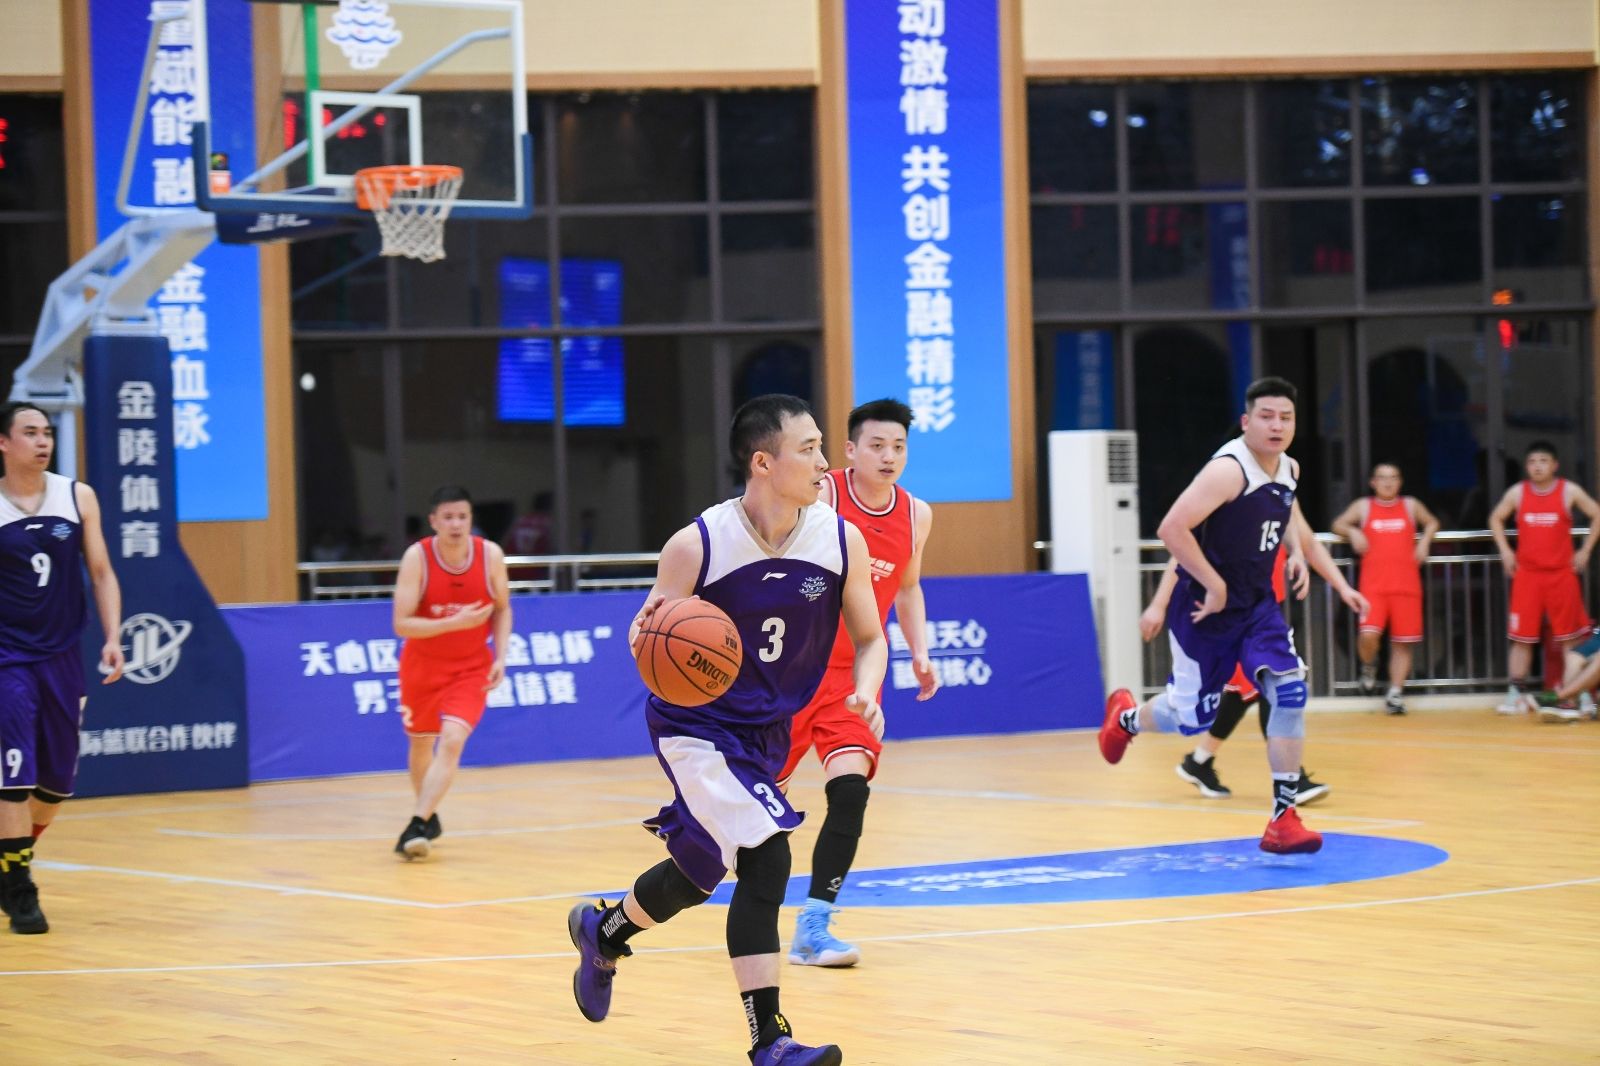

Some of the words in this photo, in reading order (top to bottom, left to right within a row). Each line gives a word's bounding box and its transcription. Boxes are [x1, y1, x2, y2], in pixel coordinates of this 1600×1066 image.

[118, 380, 160, 558] 金陵体育
[1259, 519, 1281, 552] 15
[30, 552, 51, 588] 9
[758, 616, 786, 663] 3
[6, 748, 23, 779] 9
[753, 782, 786, 818] 3
